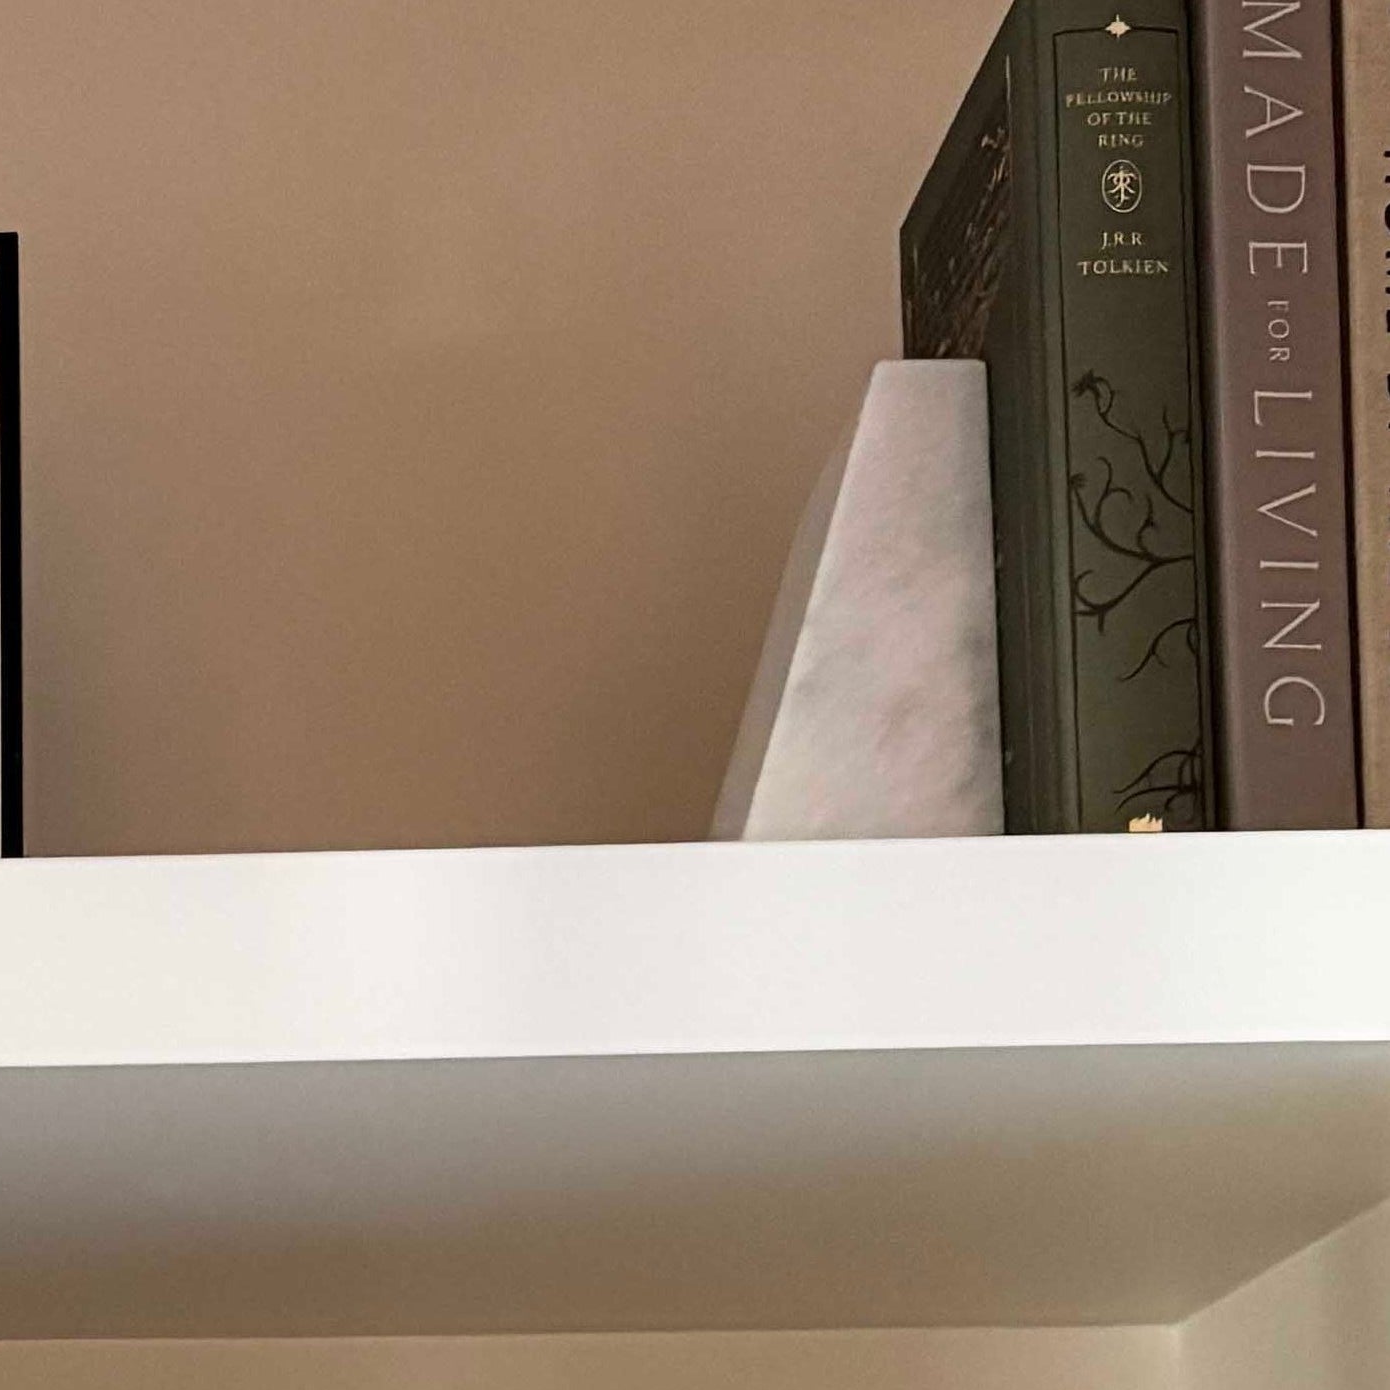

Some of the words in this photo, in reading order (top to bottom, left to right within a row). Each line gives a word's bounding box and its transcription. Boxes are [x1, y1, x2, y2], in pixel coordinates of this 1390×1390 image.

[1099, 67, 1137, 82] THE
[1065, 91, 1172, 108] FELLOWSHIP
[1087, 112, 1112, 126] OF
[1115, 112, 1152, 125] THE
[1098, 134, 1144, 148] RING
[1241, 0, 1308, 275] MADE
[1076, 260, 1169, 275] TOLKIEN
[1267, 301, 1291, 362] FOR
[1253, 390, 1326, 727] LIVING
